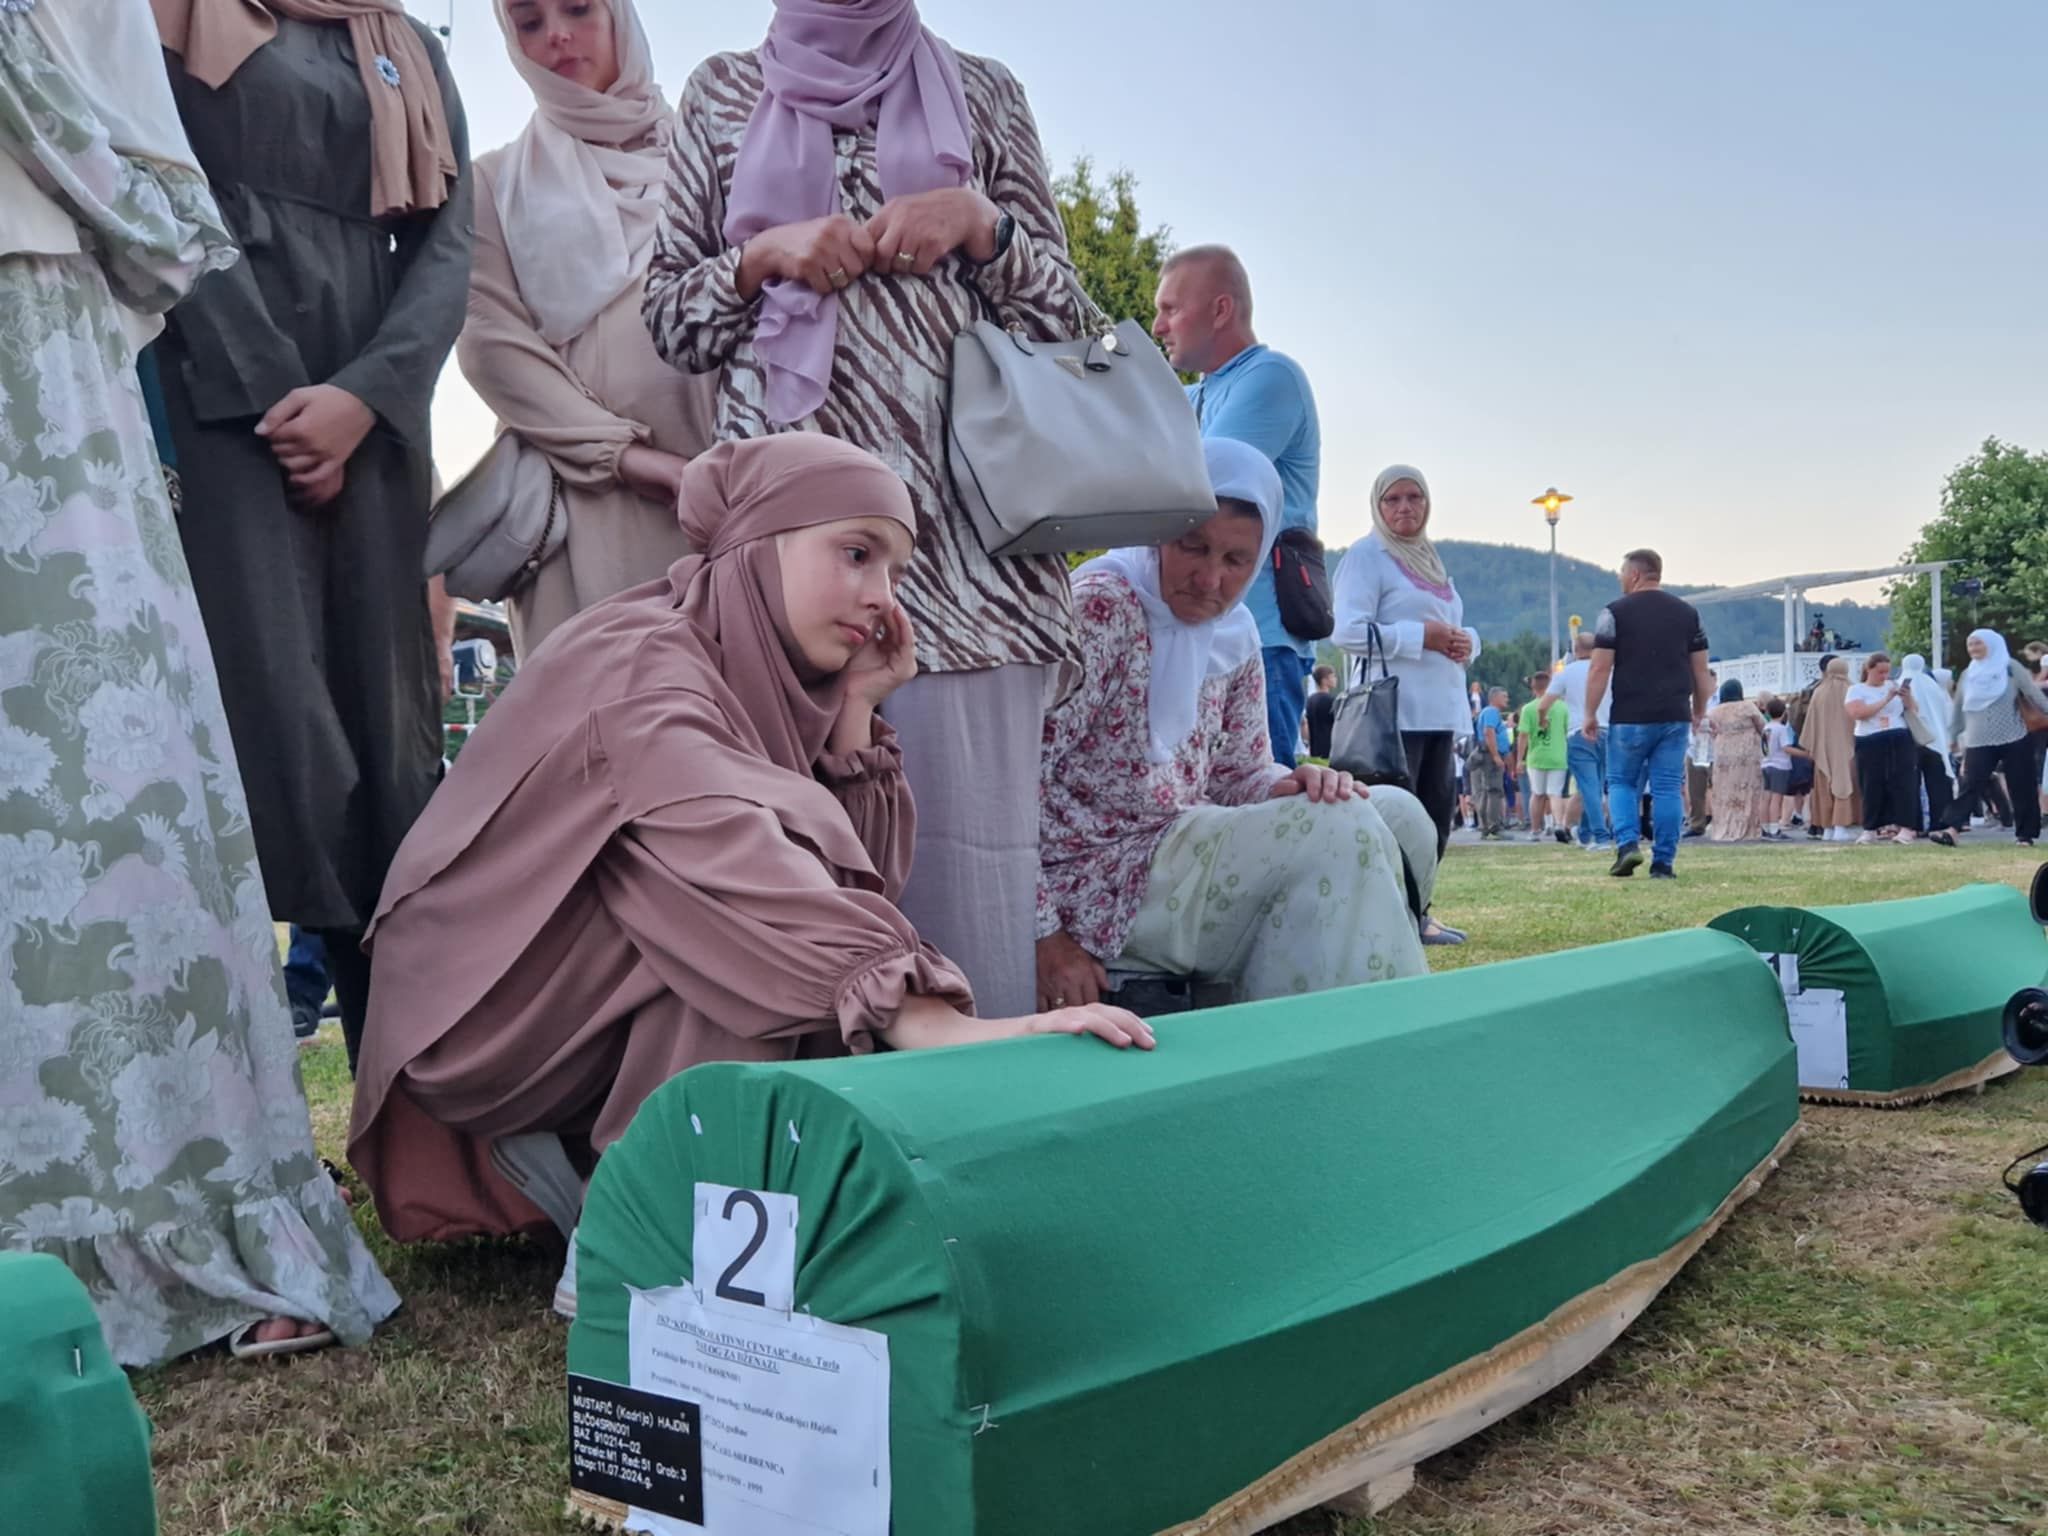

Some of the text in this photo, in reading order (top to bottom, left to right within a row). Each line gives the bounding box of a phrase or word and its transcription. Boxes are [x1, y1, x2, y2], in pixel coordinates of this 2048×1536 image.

[715, 1189, 769, 1307] 2
[573, 1425, 591, 1441] BAZ
[616, 1404, 654, 1428] (Kadrija)
[657, 1416, 690, 1435] HAJDIN
